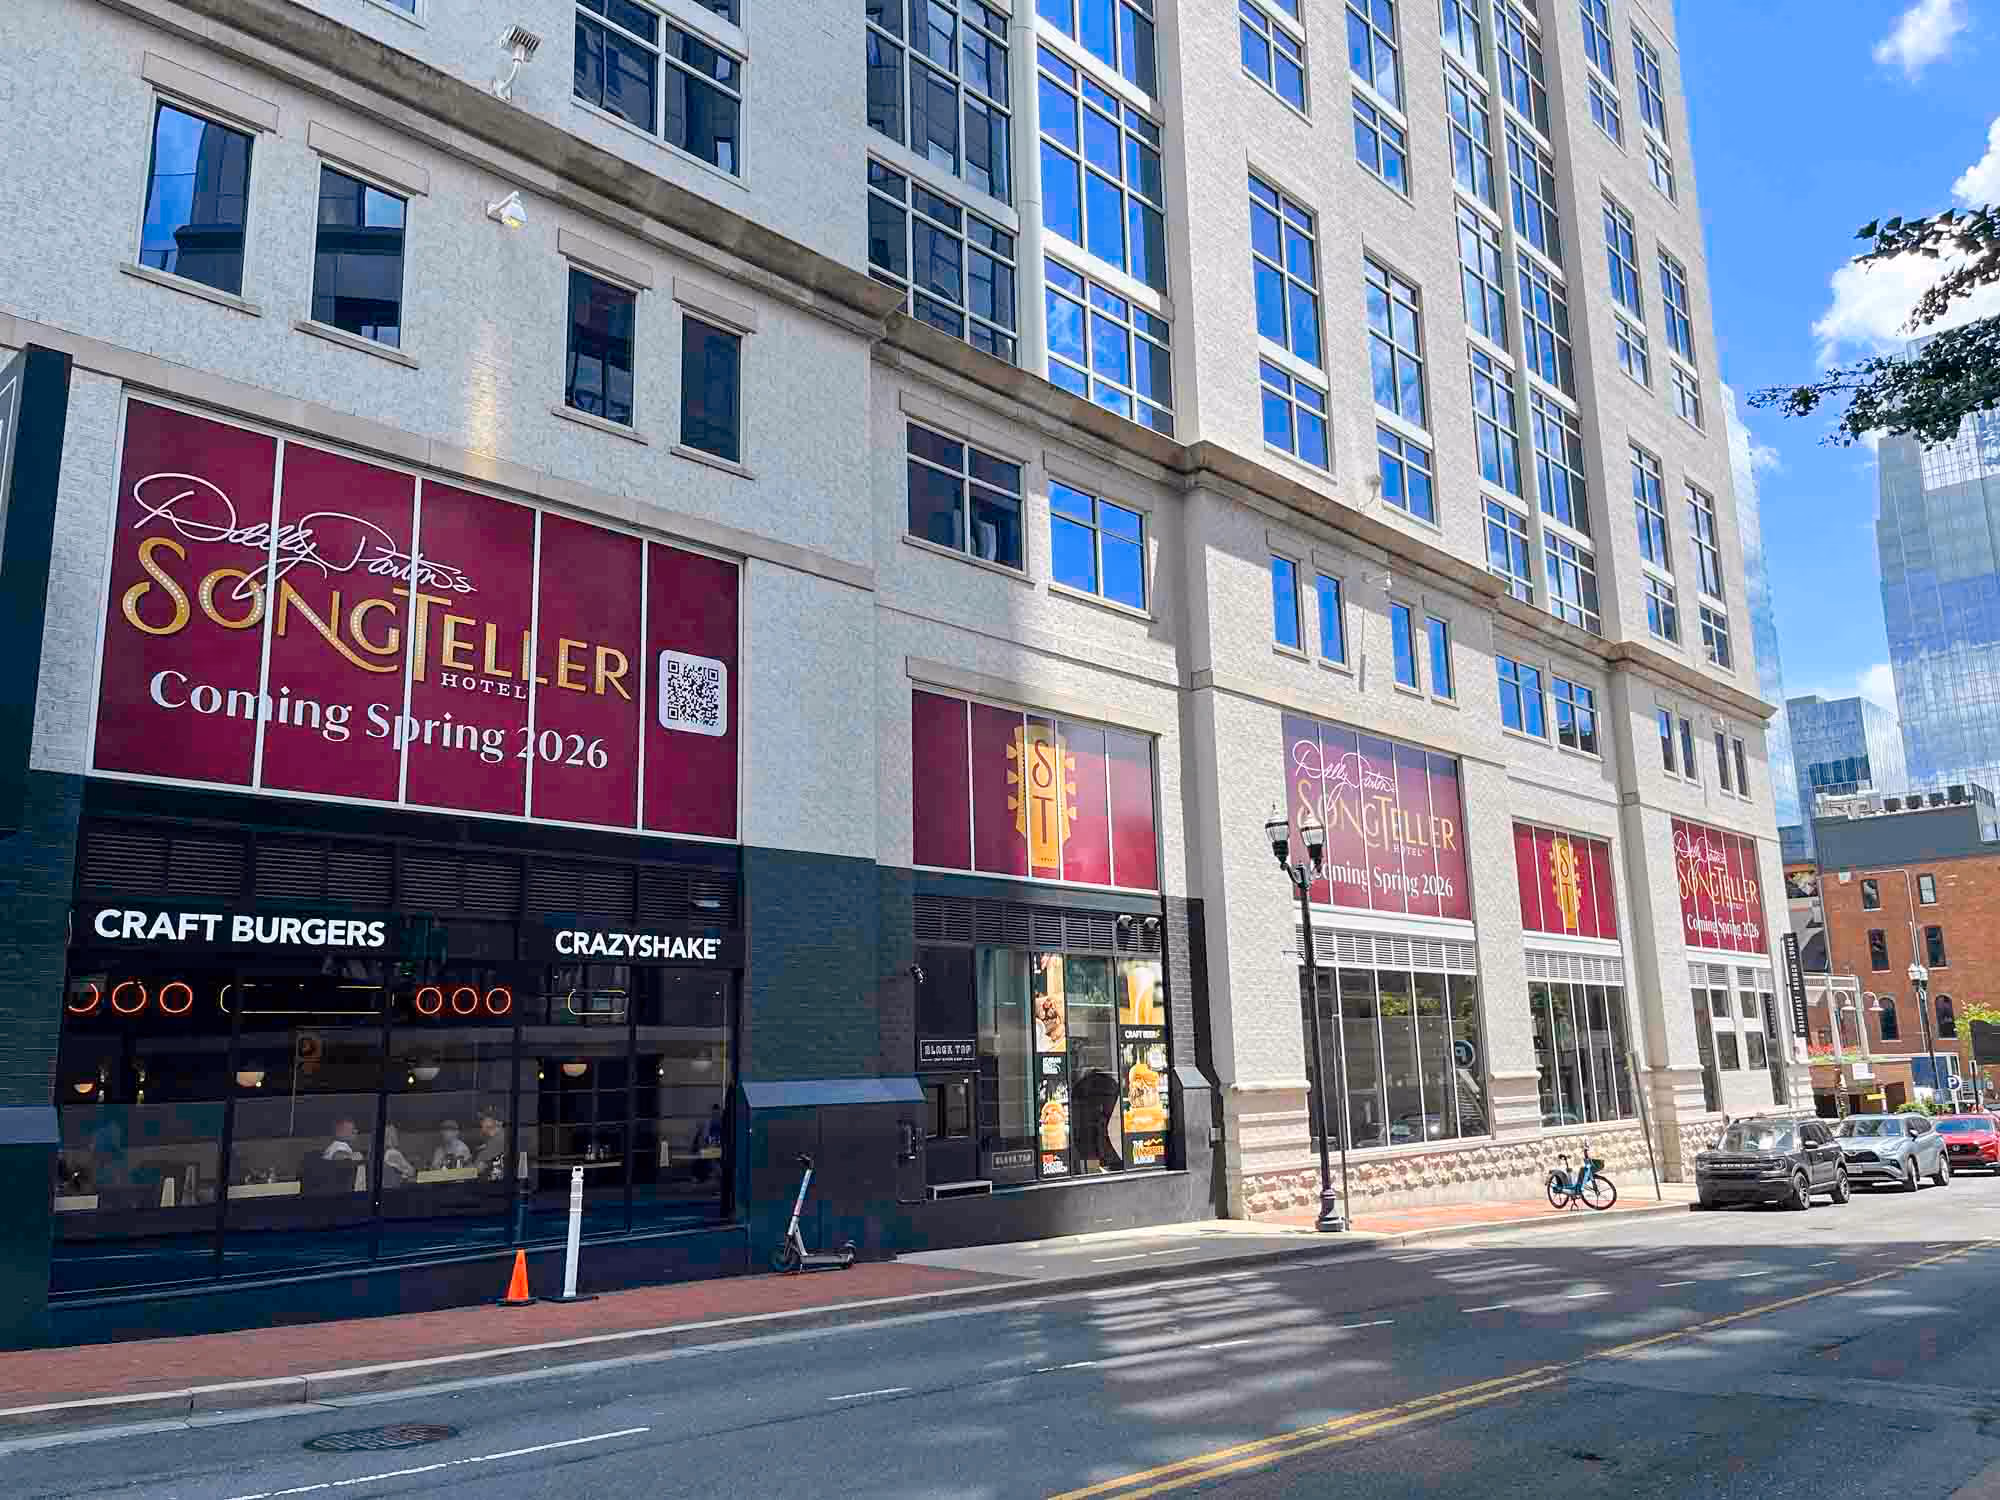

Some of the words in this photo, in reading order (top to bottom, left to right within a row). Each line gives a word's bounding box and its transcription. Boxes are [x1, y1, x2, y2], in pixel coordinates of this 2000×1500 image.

[133, 472, 327, 600] Dolly
[298, 511, 479, 594] Parton's
[122, 536, 632, 701] SONGTELLER
[441, 672, 528, 699] HOTEL
[150, 670, 353, 742] Coming
[366, 701, 505, 763] Spring
[519, 725, 609, 769] 2026
[1297, 779, 1456, 851] SONGTELLER
[1393, 843, 1424, 857] HOTEL
[1311, 860, 1369, 893] oming
[1373, 865, 1420, 897] Spring
[1421, 873, 1453, 896] 2026
[94, 909, 223, 941] CRAFT
[231, 915, 385, 947] BURGERS
[1687, 914, 1718, 937] Coming
[1718, 916, 1743, 940] Spring
[1741, 922, 1760, 939] 2026
[1787, 937, 1797, 960] LUNCH
[1794, 996, 1806, 1033] BREAKFAST
